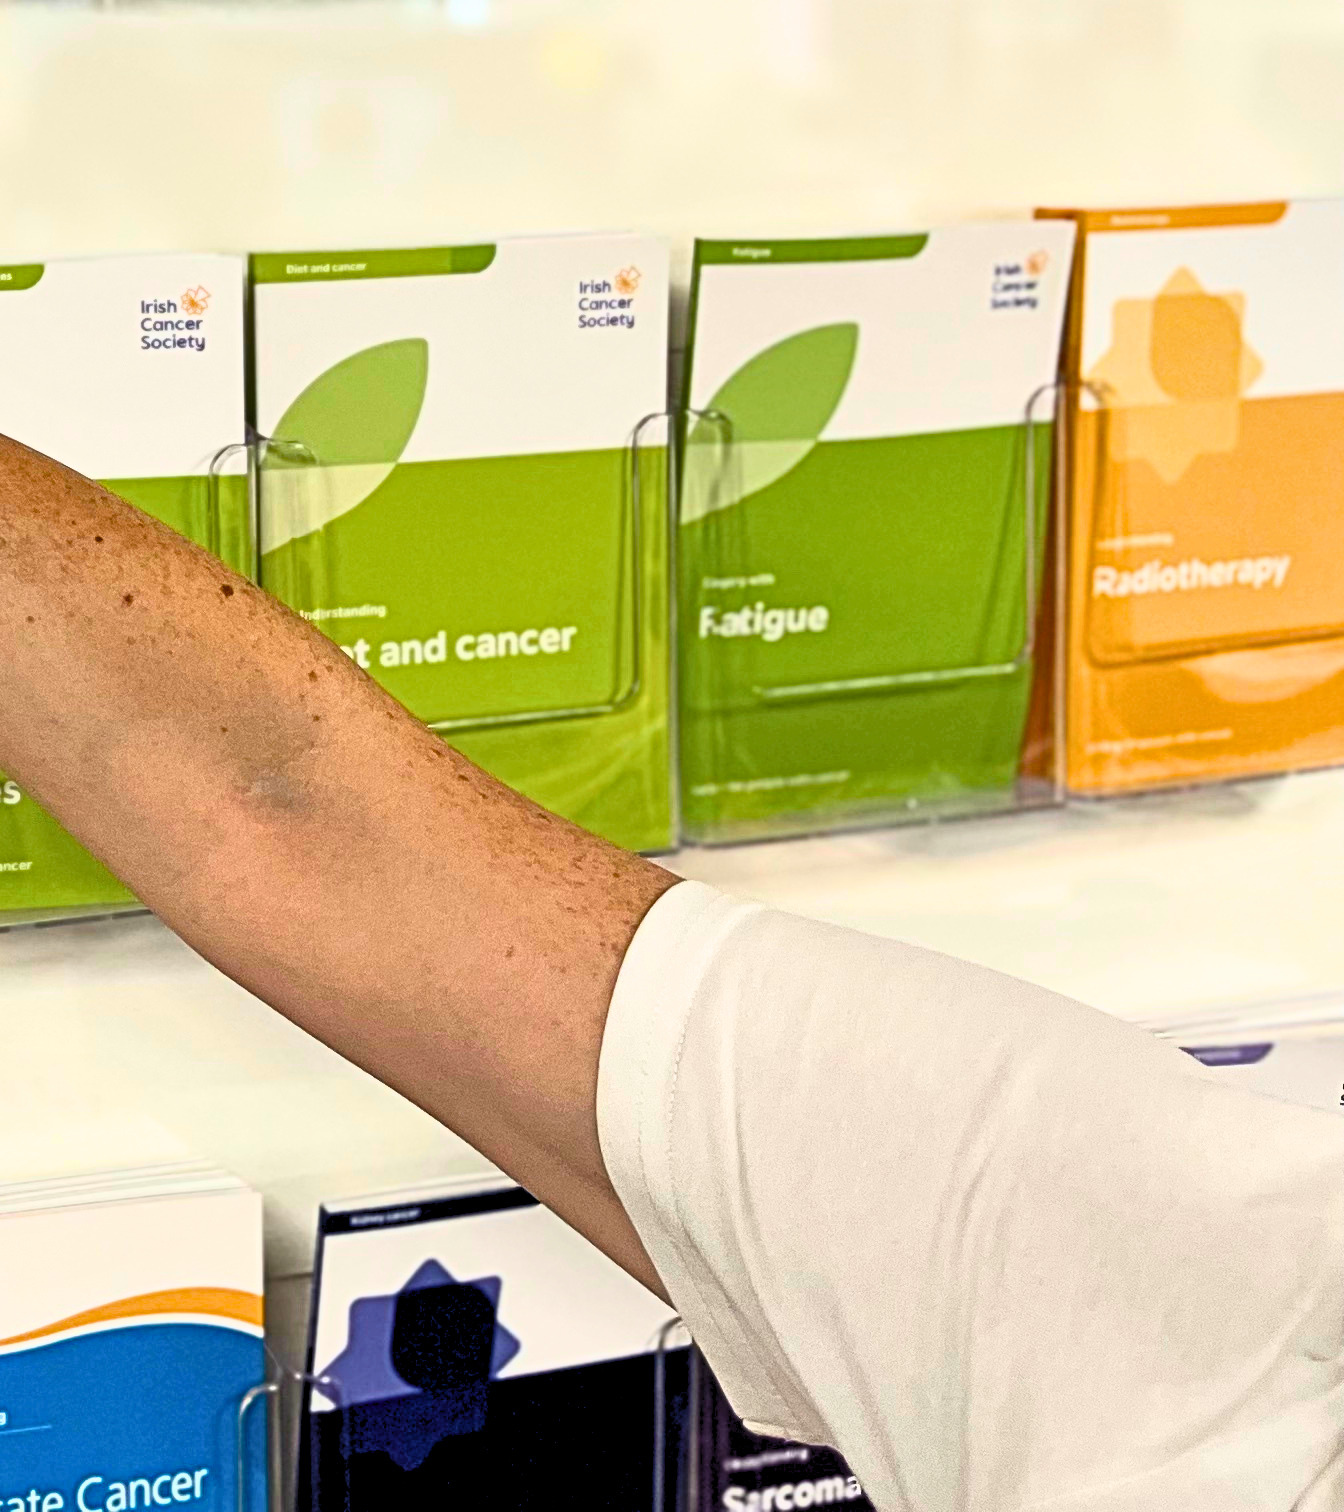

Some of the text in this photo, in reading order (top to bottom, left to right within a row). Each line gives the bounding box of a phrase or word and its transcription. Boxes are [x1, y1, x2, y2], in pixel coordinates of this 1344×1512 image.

[286, 261, 367, 274] Diet and cancer
[140, 299, 177, 315] Irish
[140, 317, 203, 333] Cancer
[140, 334, 206, 352] Society
[1093, 556, 1291, 599] Radiotherapy
[698, 600, 829, 642] Fatigue
[379, 626, 577, 668] and cancer
[75, 1467, 208, 1511] Cancer
